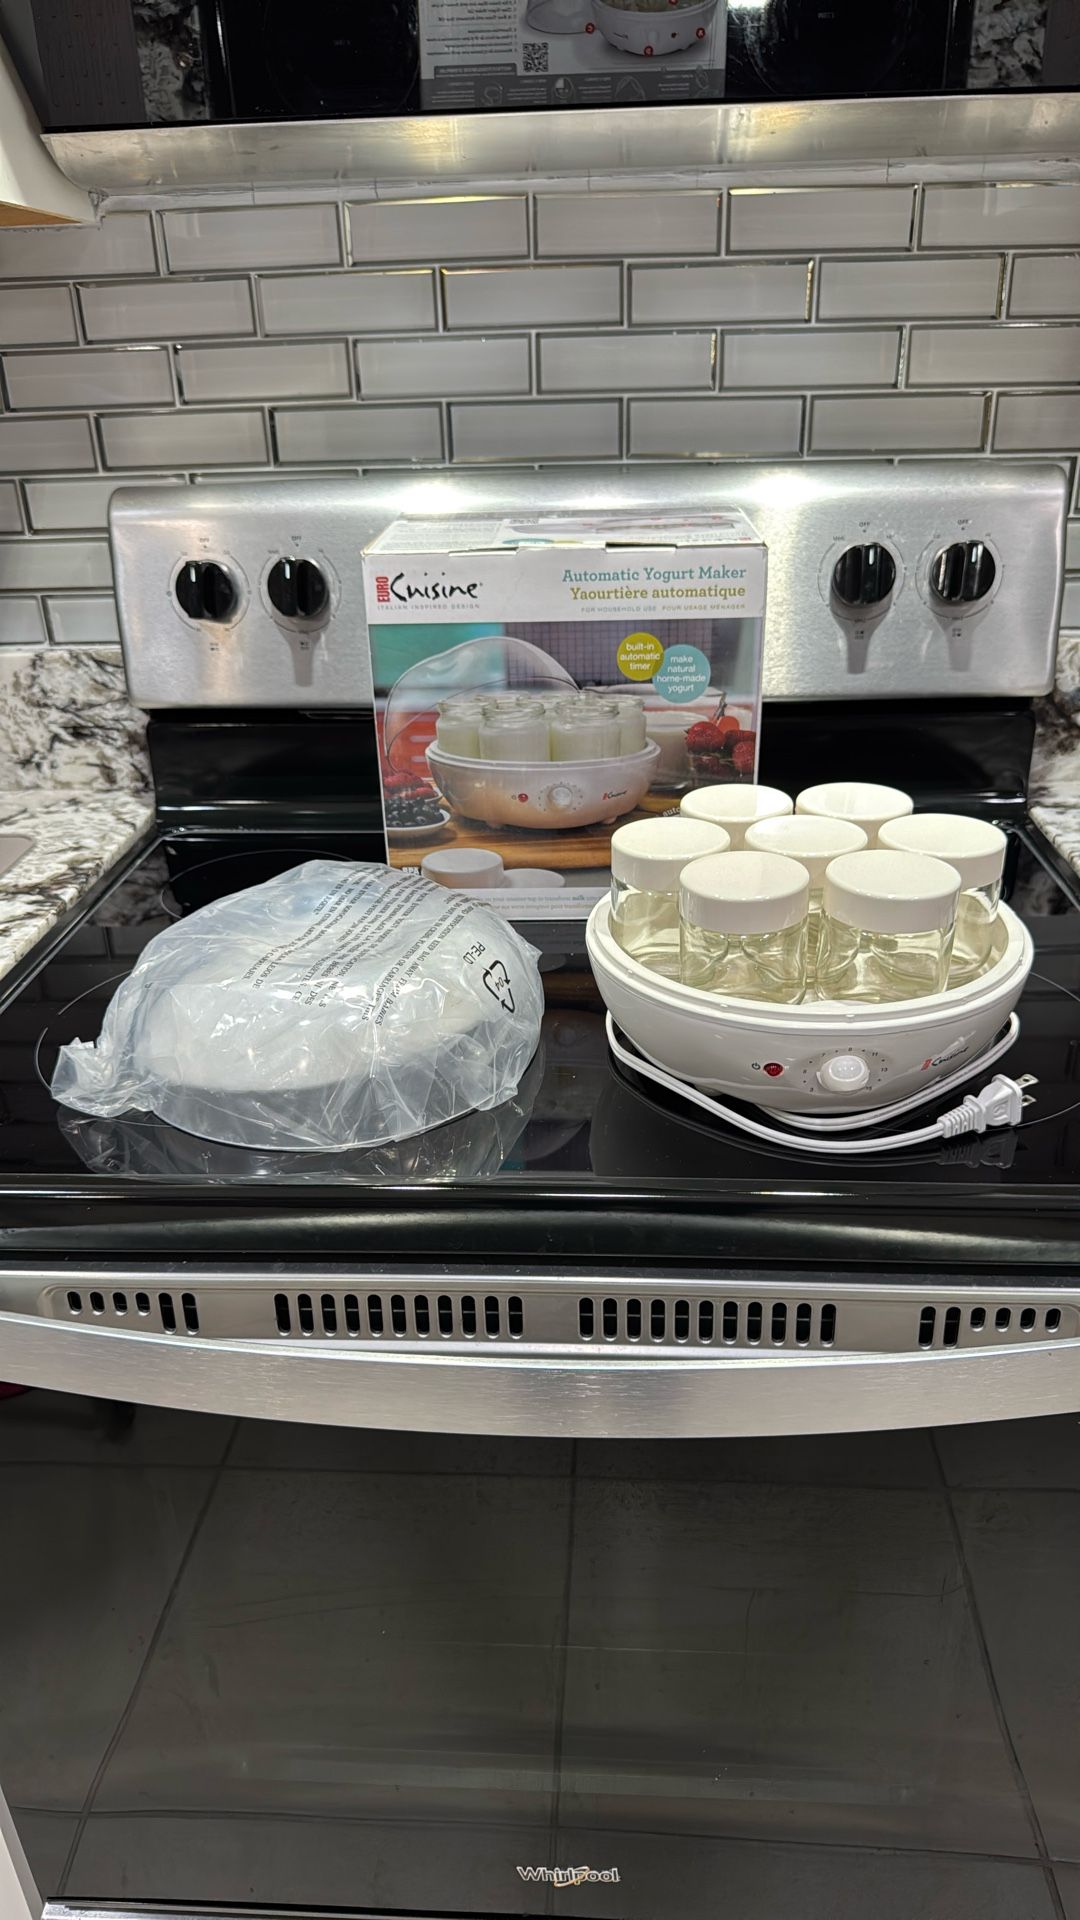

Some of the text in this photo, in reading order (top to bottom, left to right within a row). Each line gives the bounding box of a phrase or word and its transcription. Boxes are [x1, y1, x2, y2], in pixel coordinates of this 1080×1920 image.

[562, 564, 747, 583] Automatic Yogurt Maker
[375, 576, 390, 602] EURO
[390, 572, 479, 602] Cuisine
[570, 584, 746, 600] Yaourtière automatique
[626, 643, 655, 651] built-in
[620, 653, 660, 661] automatic
[670, 655, 694, 663] make
[629, 662, 651, 670] timer
[667, 664, 696, 673] natural
[656, 674, 706, 682] home-made
[668, 683, 694, 693] yogurt
[462, 942, 485, 964] PE-LD
[516, 1866, 620, 1887] Whirlpool
